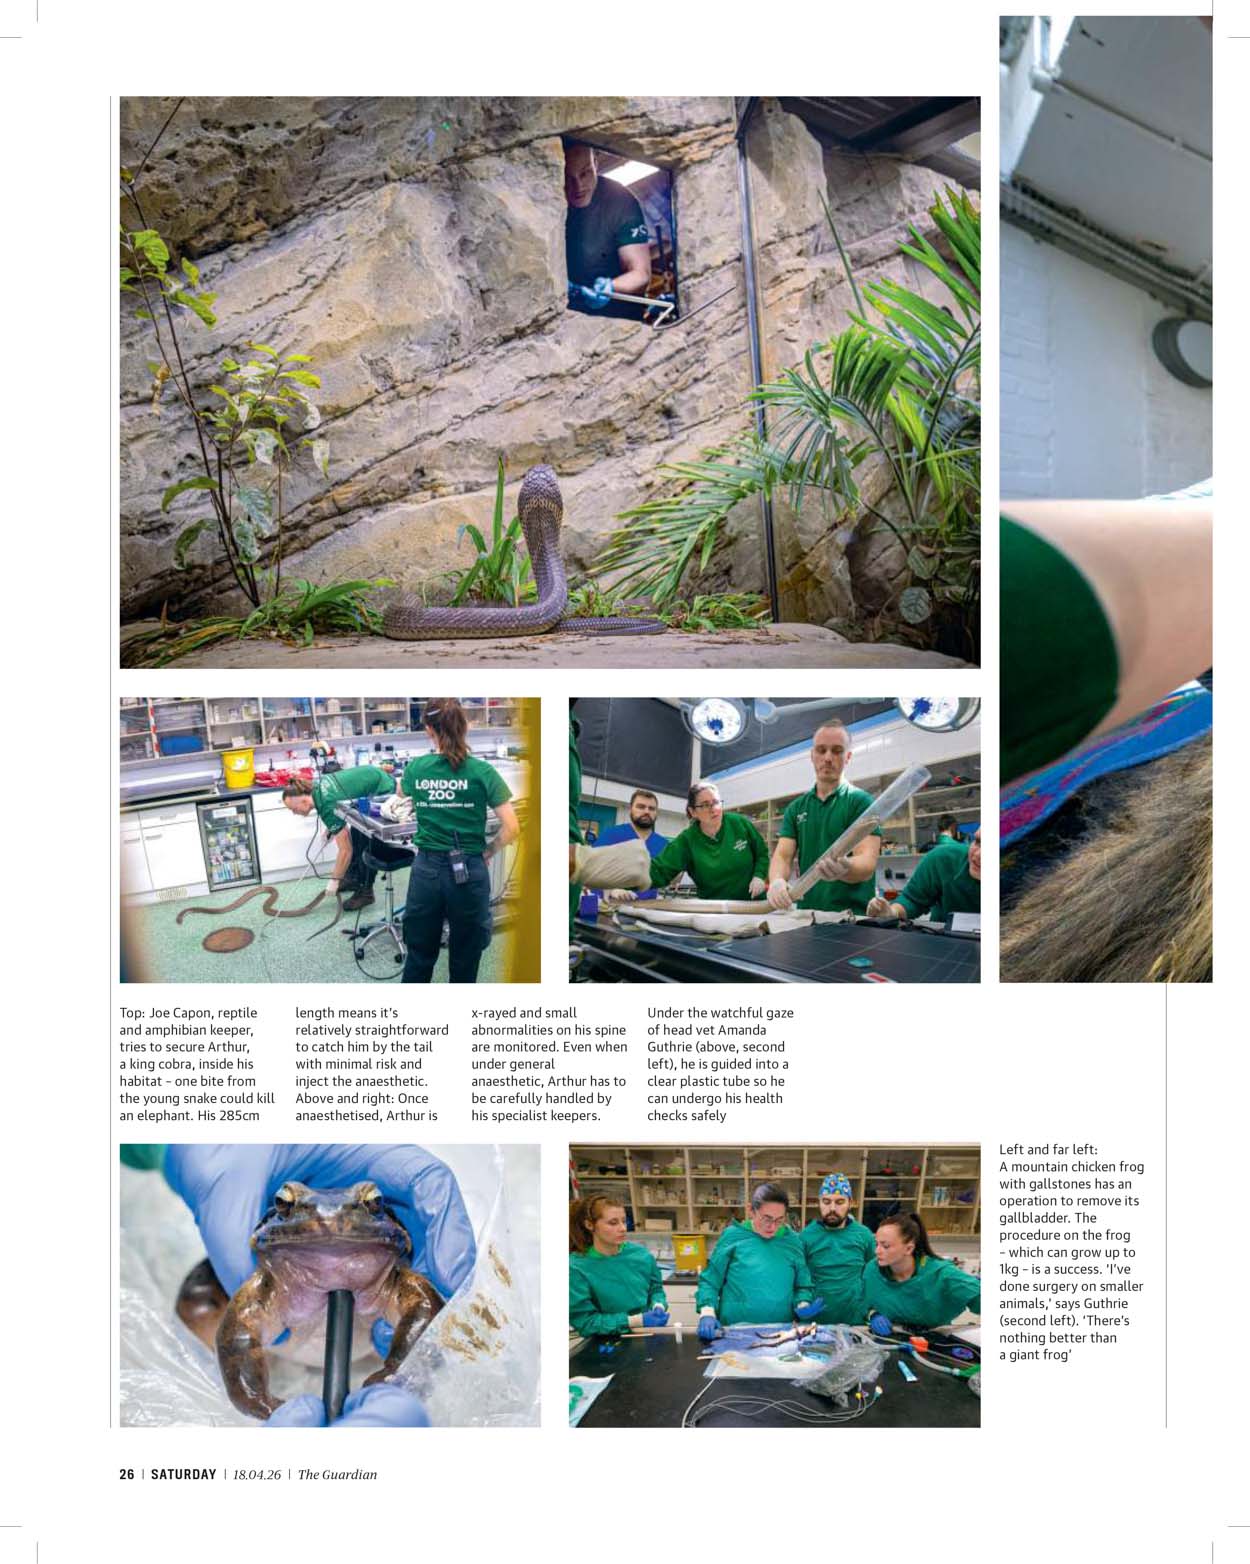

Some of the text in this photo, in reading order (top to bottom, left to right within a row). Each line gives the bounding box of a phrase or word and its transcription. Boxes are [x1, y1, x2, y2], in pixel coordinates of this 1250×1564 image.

[415, 779, 468, 790] LONDON
[428, 790, 455, 800] ZOO
[120, 1007, 257, 1021] Top: Joe Capon, reptile
[472, 1007, 577, 1020] x-rayed and small
[648, 1007, 794, 1021] Under the watchful gaze
[120, 1024, 253, 1038] and amphibian keeper,
[296, 1024, 448, 1038] relatively straightforward
[472, 1024, 626, 1038] abnormalities on his spine
[648, 1024, 766, 1035] of head vet Amanda
[120, 1041, 249, 1054] tries to secure Arthur,
[296, 1041, 432, 1054] to catch him by the tail
[472, 1041, 627, 1052] are monitored. Even when
[648, 1041, 784, 1054] Guthrie (above, second
[120, 1058, 253, 1072] a king cobra, inside his
[296, 1058, 421, 1069] with minimal risk and
[472, 1058, 555, 1072] under general
[296, 1075, 427, 1089] inject the anaesthetic.
[296, 1092, 428, 1106] Above and right: Once
[1000, 1144, 1097, 1155] Left and far left:
[1000, 1161, 1144, 1174] A mountain chicken frog
[1000, 1178, 1131, 1192] with gallstones has an
[1000, 1195, 1139, 1208] operation to remove its
[1000, 1212, 1096, 1226] gallbladder. The
[1000, 1229, 1130, 1243] procedure on the frog
[1000, 1280, 1029, 1291] done
[1033, 1284, 1078, 1294] surgery
[1100, 1280, 1143, 1291] smaller
[1000, 1332, 1116, 1345] nothing better than
[120, 1469, 377, 1480] 26 SATURDAY 18.04.26 The Guardian
